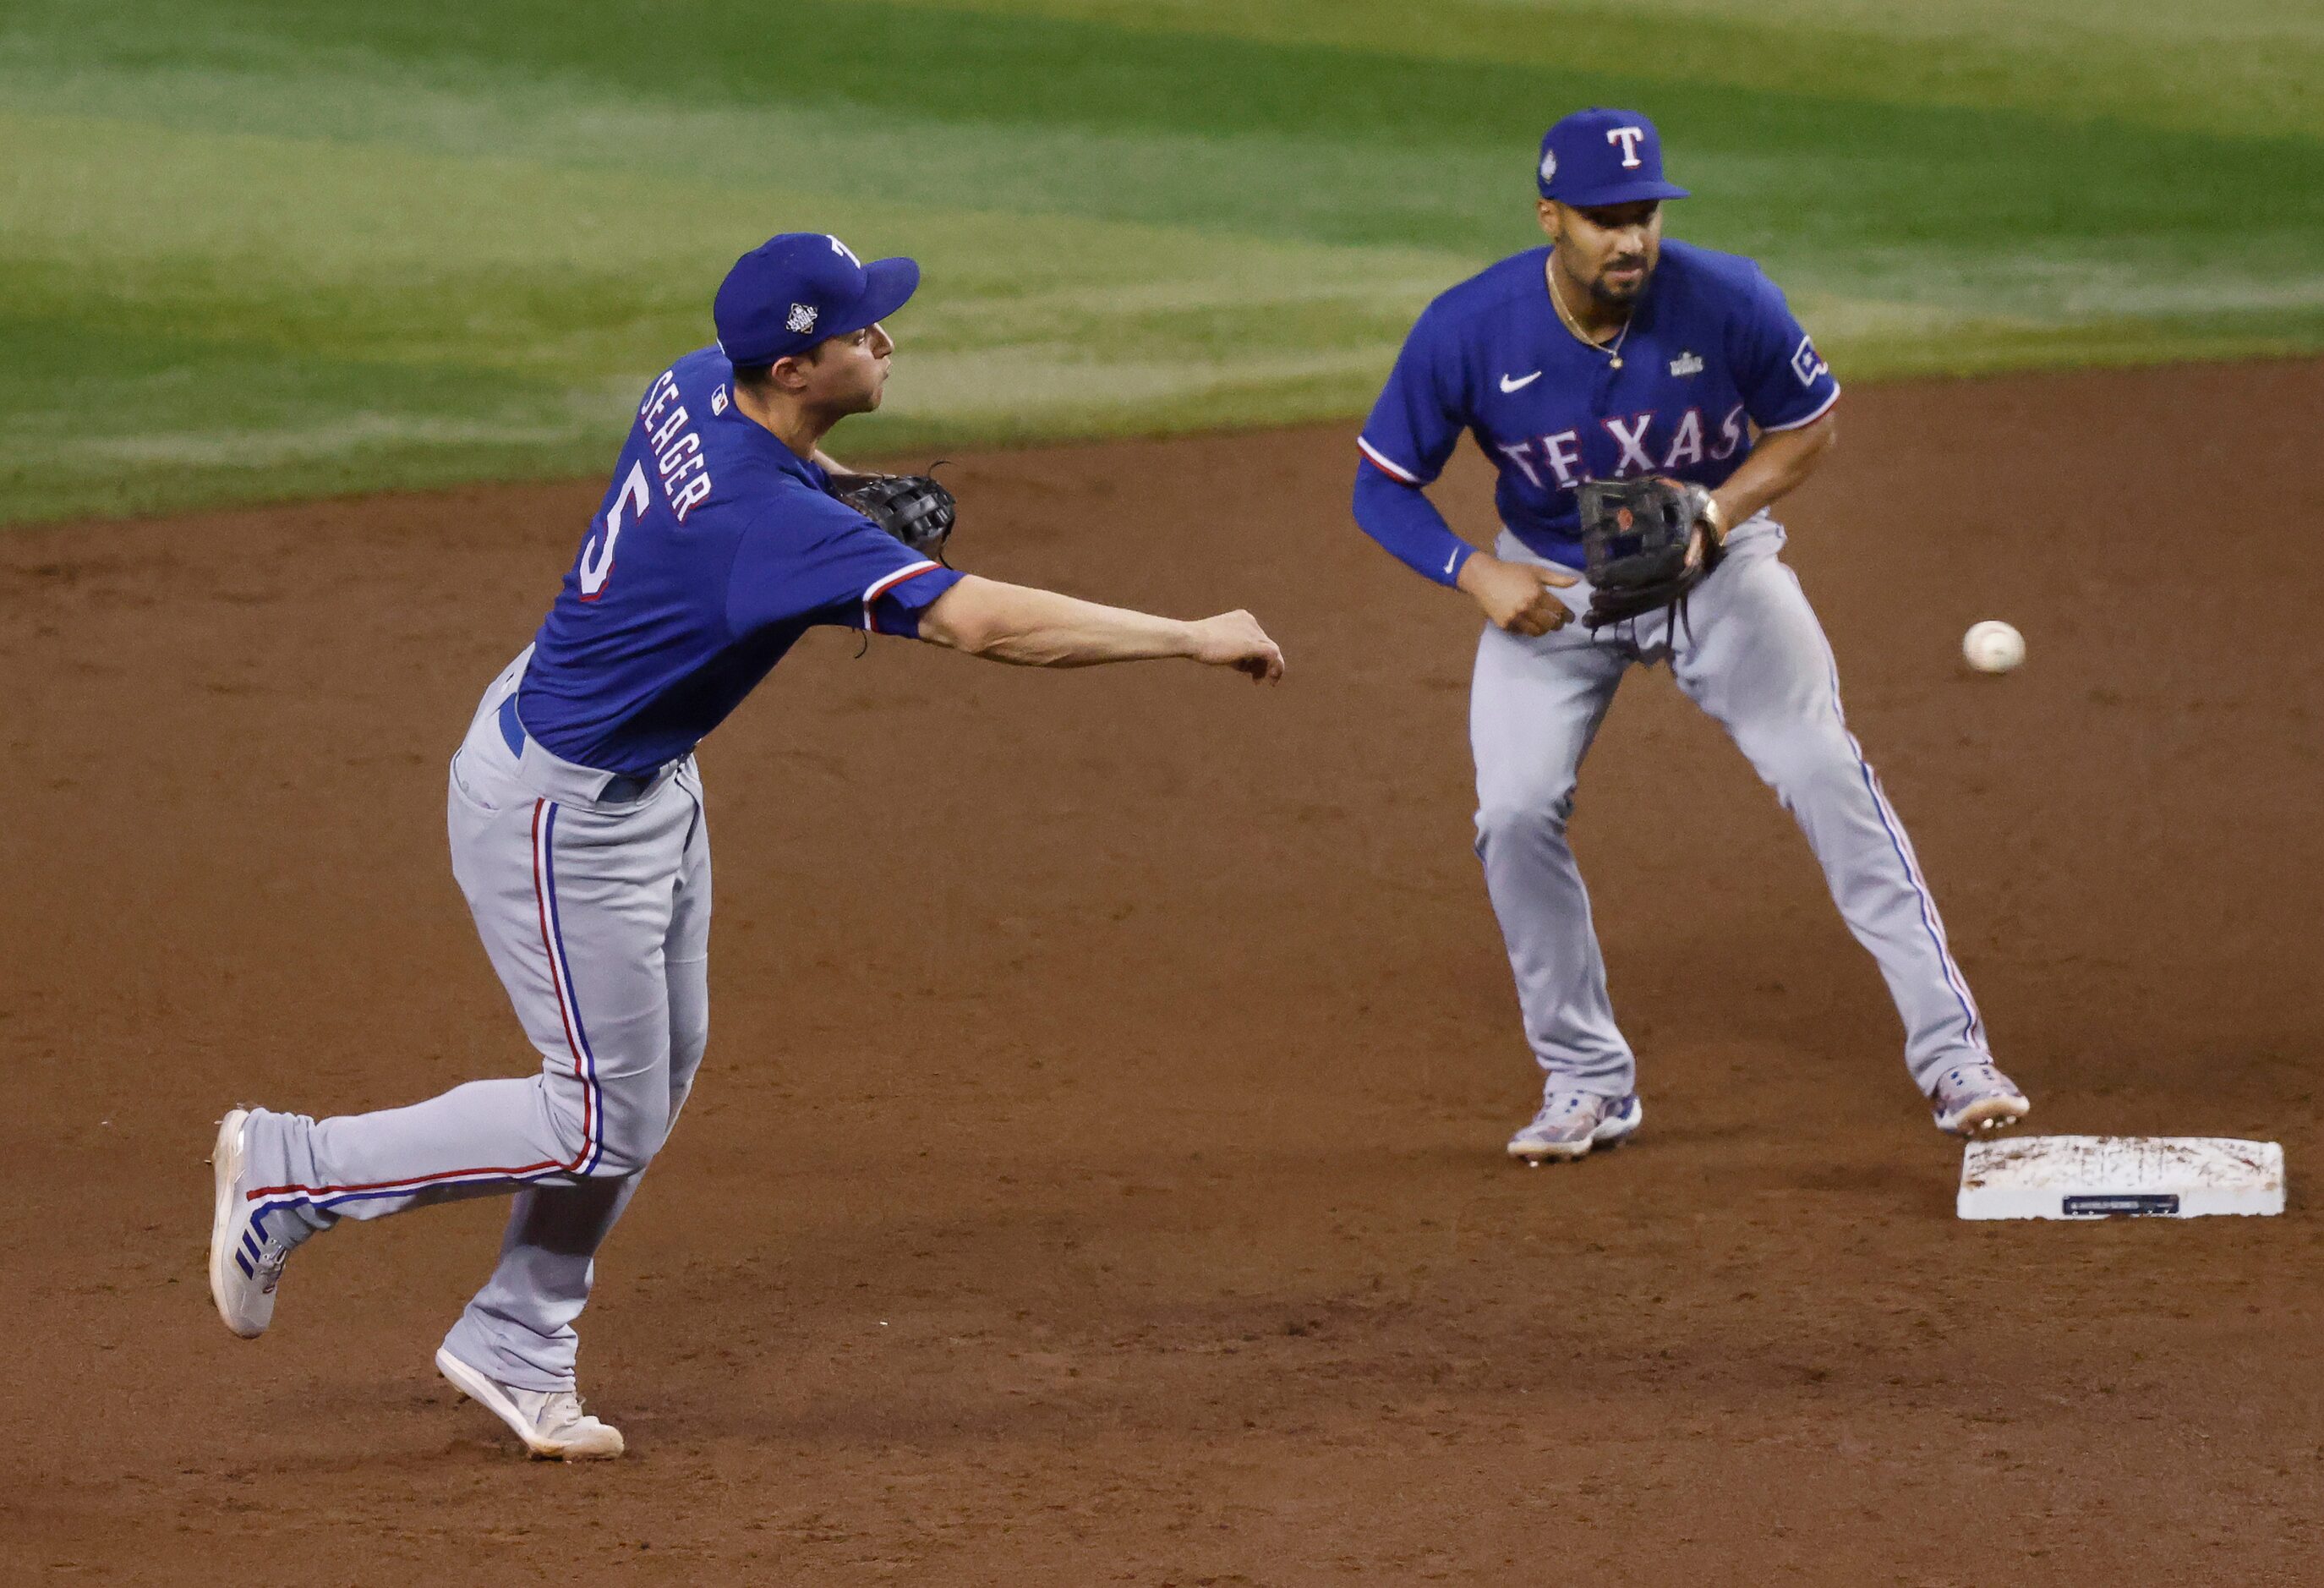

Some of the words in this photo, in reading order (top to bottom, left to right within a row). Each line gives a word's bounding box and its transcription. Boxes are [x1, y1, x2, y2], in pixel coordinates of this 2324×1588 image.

[1606, 126, 1644, 169] T
[639, 370, 713, 525] SEAGER
[1496, 403, 1745, 490] TEXAS
[579, 458, 651, 602] 5
